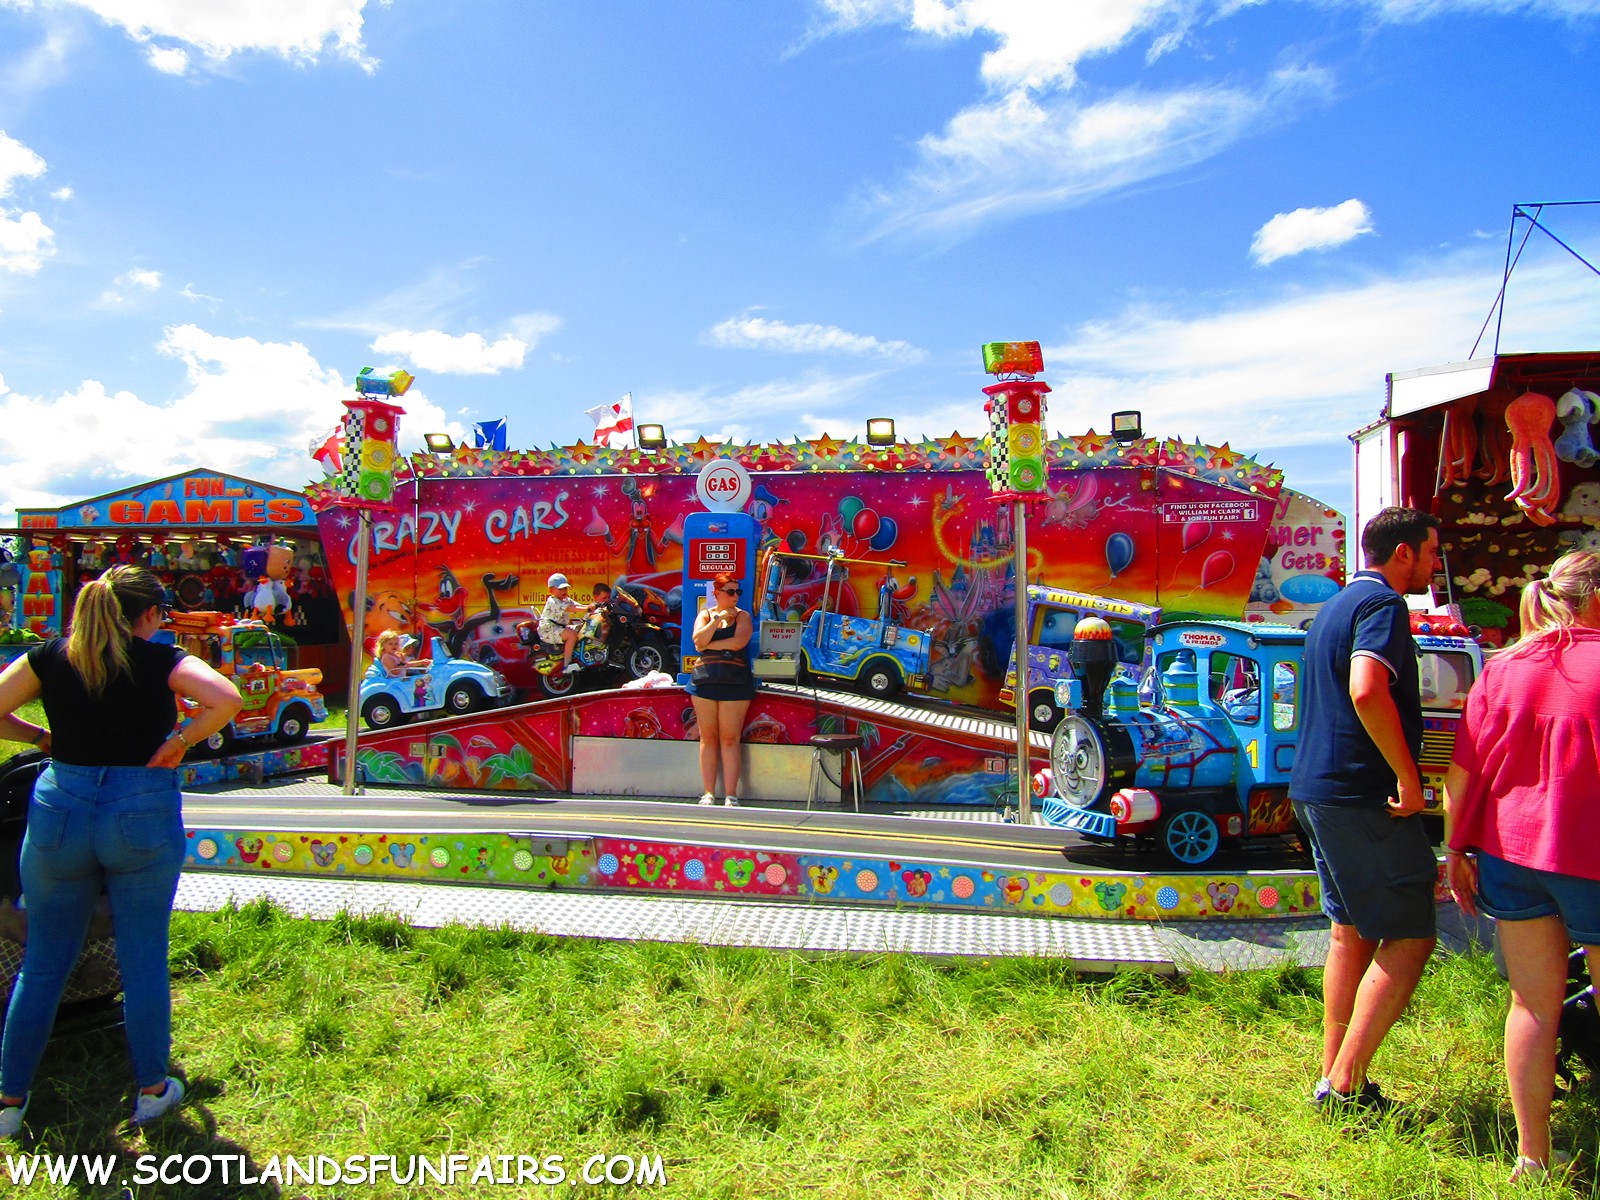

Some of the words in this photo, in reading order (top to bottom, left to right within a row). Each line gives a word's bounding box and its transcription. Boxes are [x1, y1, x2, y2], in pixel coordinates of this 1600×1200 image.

[184, 477, 225, 498] FUN
[707, 477, 738, 492] GAS
[21, 514, 58, 529] FUN
[109, 499, 304, 525] GAMES
[484, 491, 570, 544] CARS
[1281, 551, 1326, 570] Gets
[1329, 556, 1340, 569] a
[1183, 633, 1222, 641] THOMAS
[1246, 738, 1258, 769] 1
